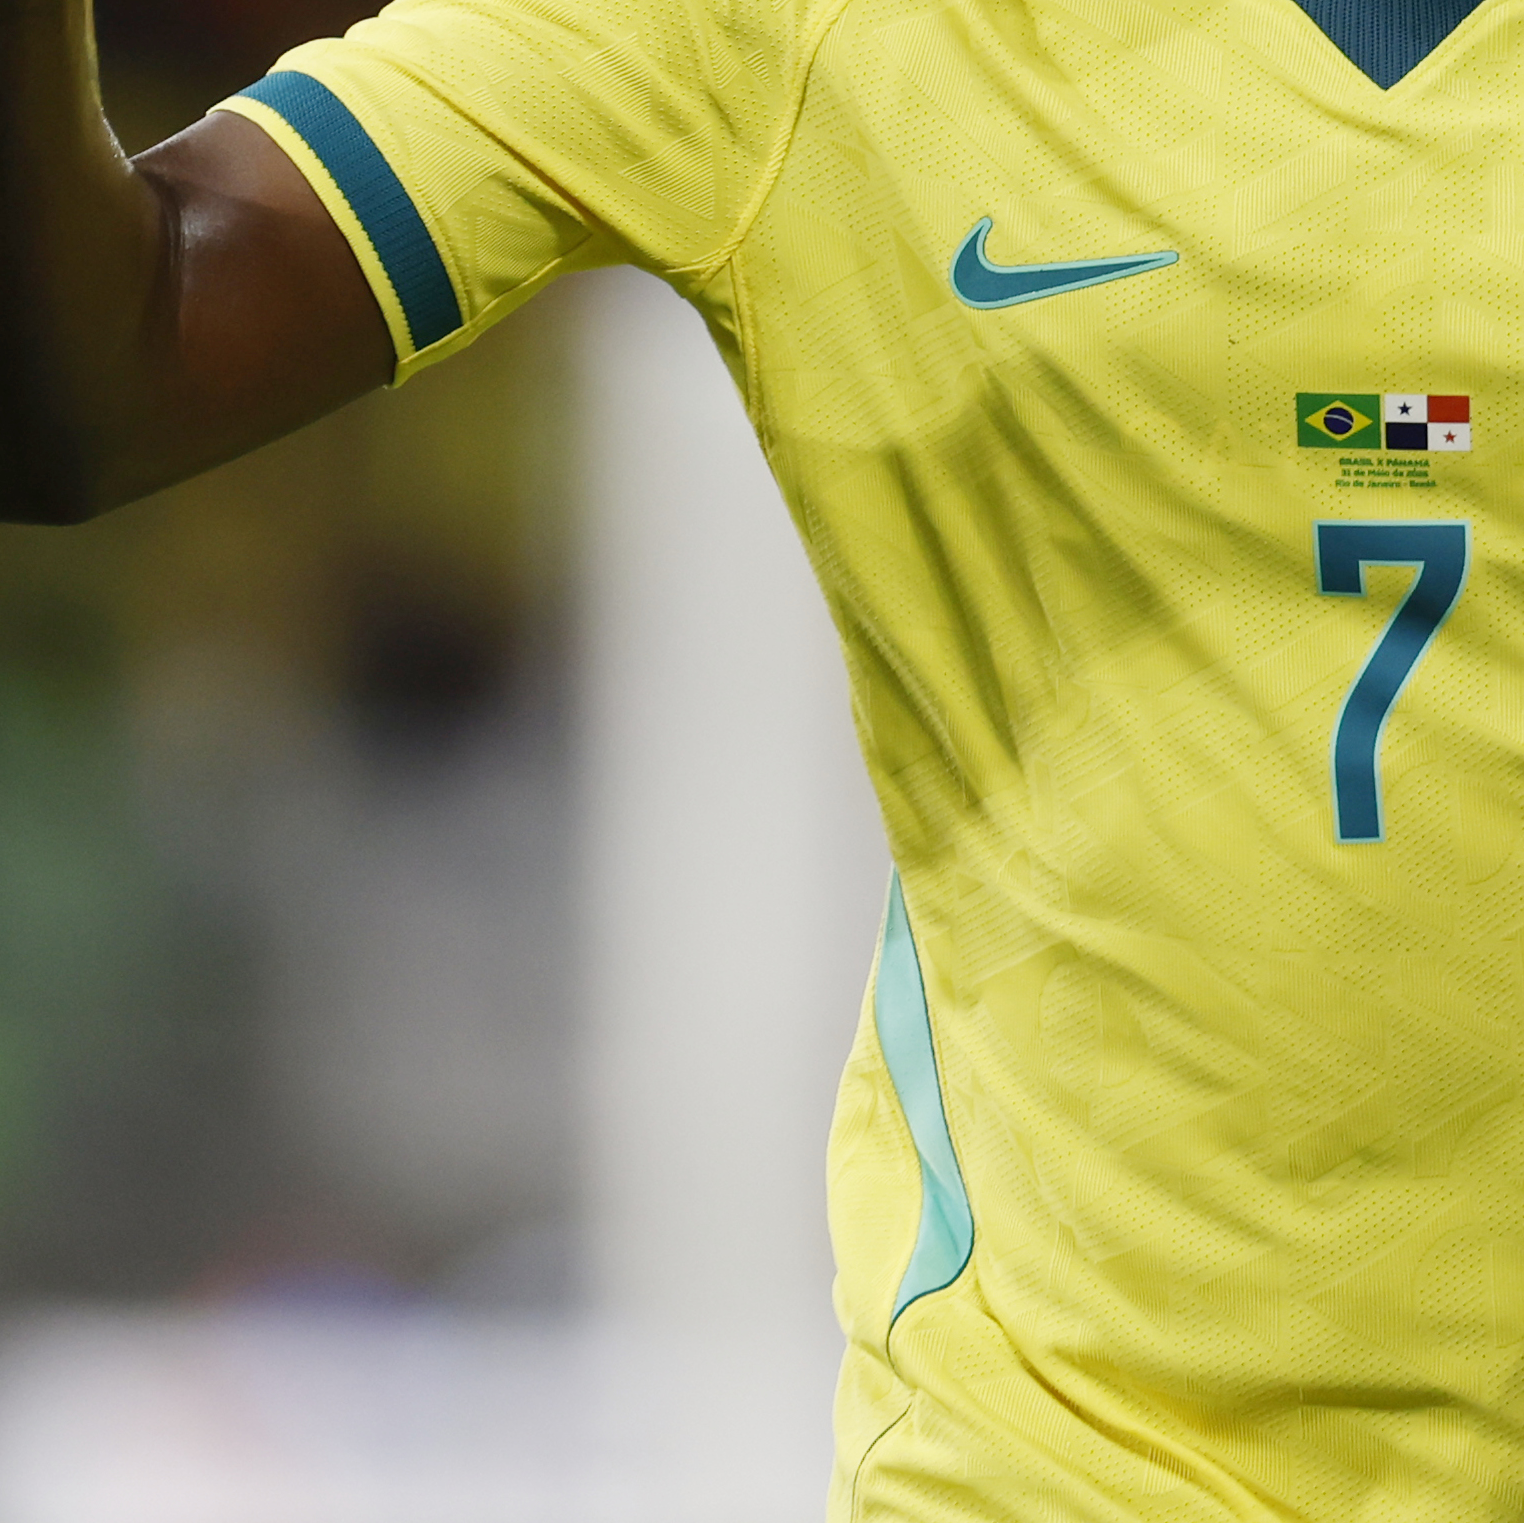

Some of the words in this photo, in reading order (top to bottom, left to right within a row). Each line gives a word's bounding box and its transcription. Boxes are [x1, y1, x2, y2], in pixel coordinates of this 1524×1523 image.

[1339, 458, 1373, 466] BRASIL
[1354, 469, 1365, 477] de
[1367, 480, 1400, 488] Janeiro
[1312, 519, 1472, 845] 7
